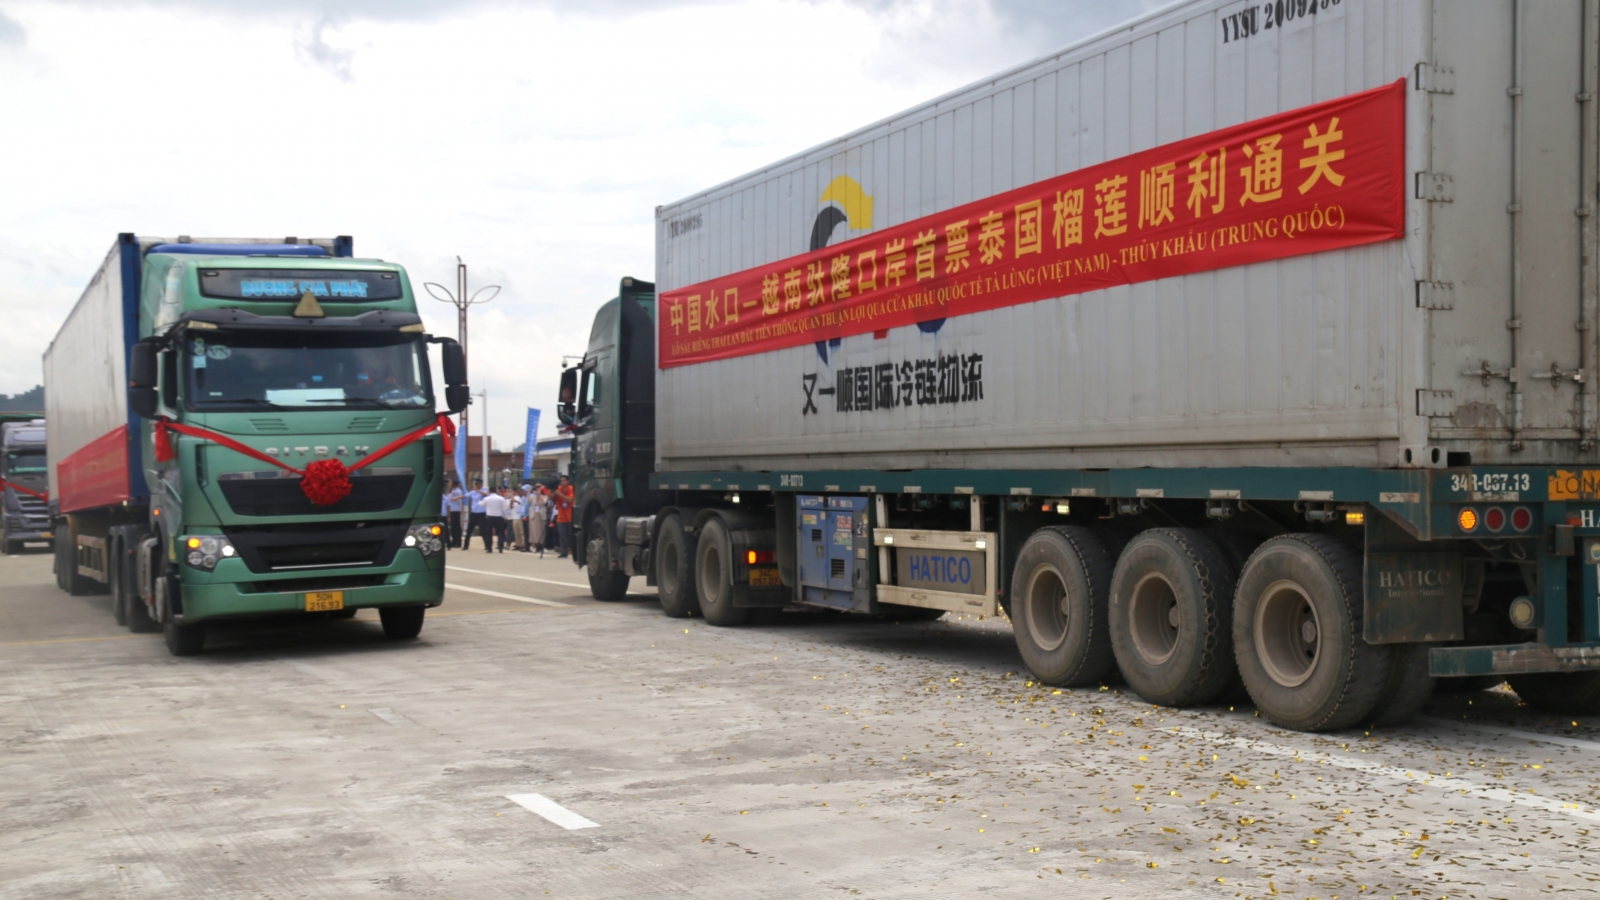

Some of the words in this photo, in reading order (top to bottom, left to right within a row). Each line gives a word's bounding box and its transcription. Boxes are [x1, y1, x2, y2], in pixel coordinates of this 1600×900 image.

[1221, 5, 1260, 44] YYSU
[772, 319, 798, 338] THÔNG
[799, 315, 821, 334] QUAN
[821, 308, 849, 326] THUẬN
[850, 303, 866, 322] LỢI
[866, 301, 886, 319] QUA
[937, 280, 967, 305] QUỐC
[969, 275, 983, 296] TẾ
[985, 272, 1000, 293] TÀ
[1002, 268, 1035, 290] LÙNG
[1037, 259, 1072, 286] (VIỆT
[1074, 253, 1110, 275] NAM)
[1119, 238, 1160, 266] THỦY
[1211, 218, 1279, 252] (TRUNG
[1282, 203, 1345, 239] QUỐC)
[802, 352, 984, 416] 又一顺国际冷链物流
[265, 445, 370, 458] SITRAK
[1580, 509, 1600, 528] H
[909, 555, 971, 584] HATICO
[1379, 569, 1452, 588] HATICO
